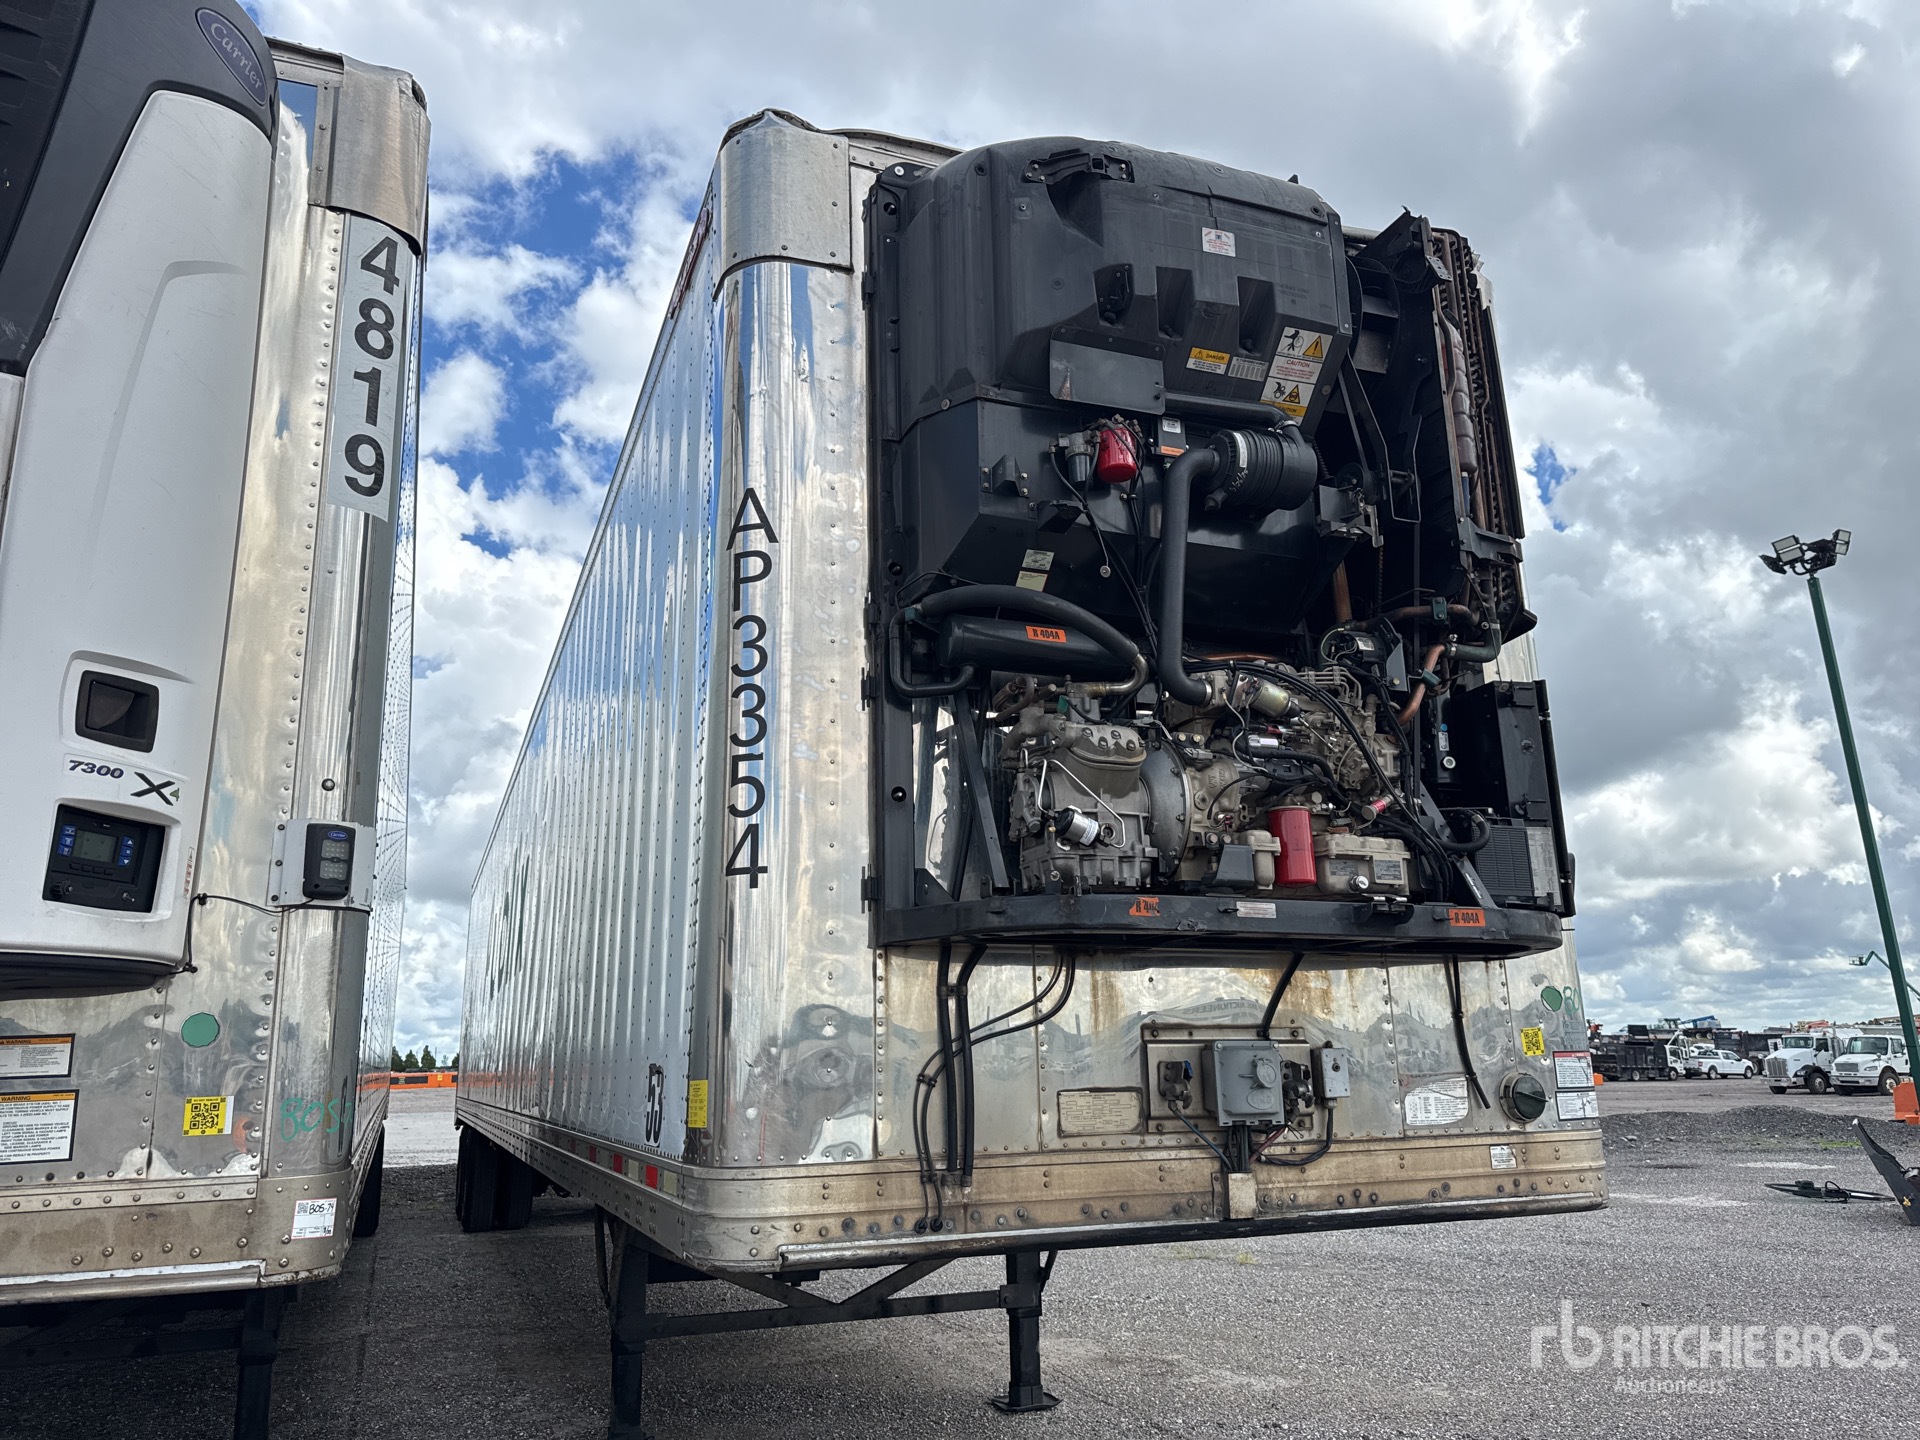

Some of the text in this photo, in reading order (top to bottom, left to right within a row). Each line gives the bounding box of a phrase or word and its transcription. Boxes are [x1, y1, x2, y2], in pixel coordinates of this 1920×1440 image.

[211, 23, 262, 88] Carrier
[1206, 353, 1225, 361] DANGER
[1286, 359, 1311, 368] CAUTION
[344, 236, 400, 497] 4819
[1032, 628, 1060, 640] R 404A
[726, 488, 779, 888] AP3354
[69, 760, 124, 779] 7300
[1454, 912, 1480, 924] R 404A
